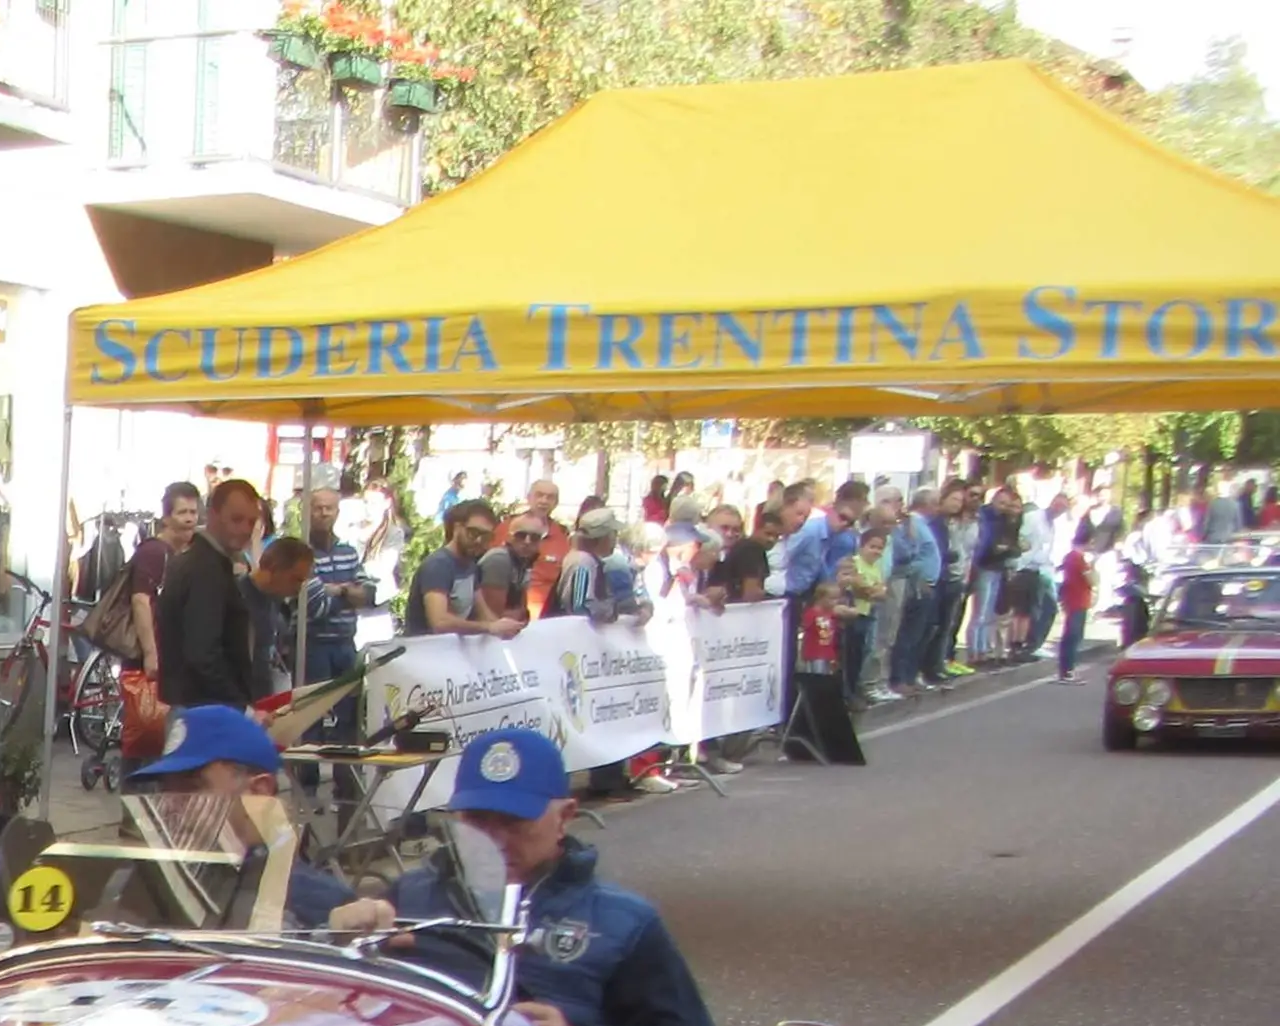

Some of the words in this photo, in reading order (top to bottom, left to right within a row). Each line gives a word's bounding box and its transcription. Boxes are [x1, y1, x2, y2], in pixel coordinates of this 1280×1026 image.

[91, 316, 499, 386] SCUDERIA
[527, 299, 986, 372] TRENTINA
[16, 884, 65, 914] 14
